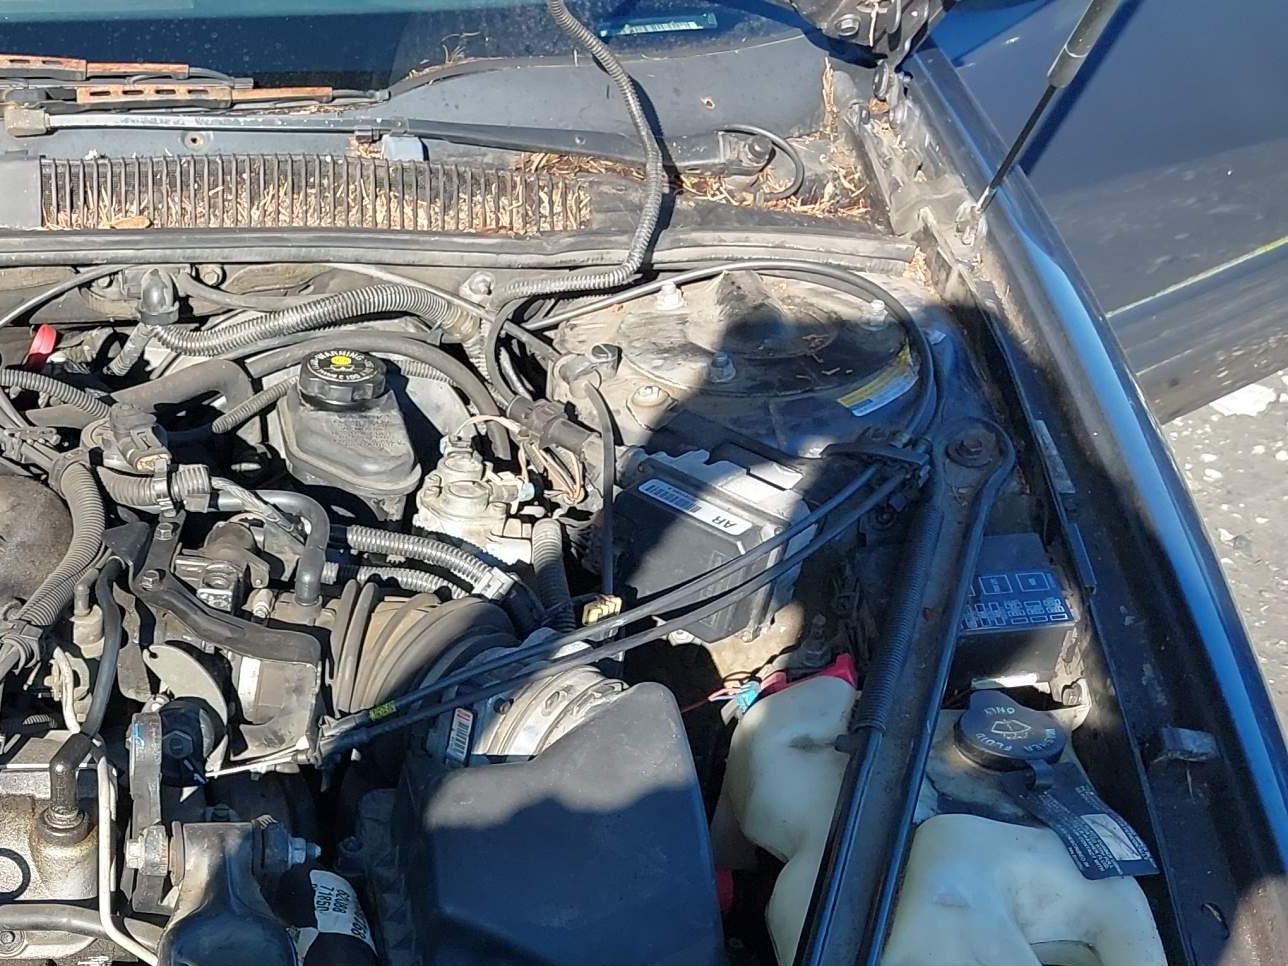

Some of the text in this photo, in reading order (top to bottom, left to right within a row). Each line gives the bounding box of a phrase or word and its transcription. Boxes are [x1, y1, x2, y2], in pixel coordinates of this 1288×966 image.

[315, 350, 365, 361] WARNING
[711, 515, 737, 529] AR
[975, 732, 1013, 751] FLUID
